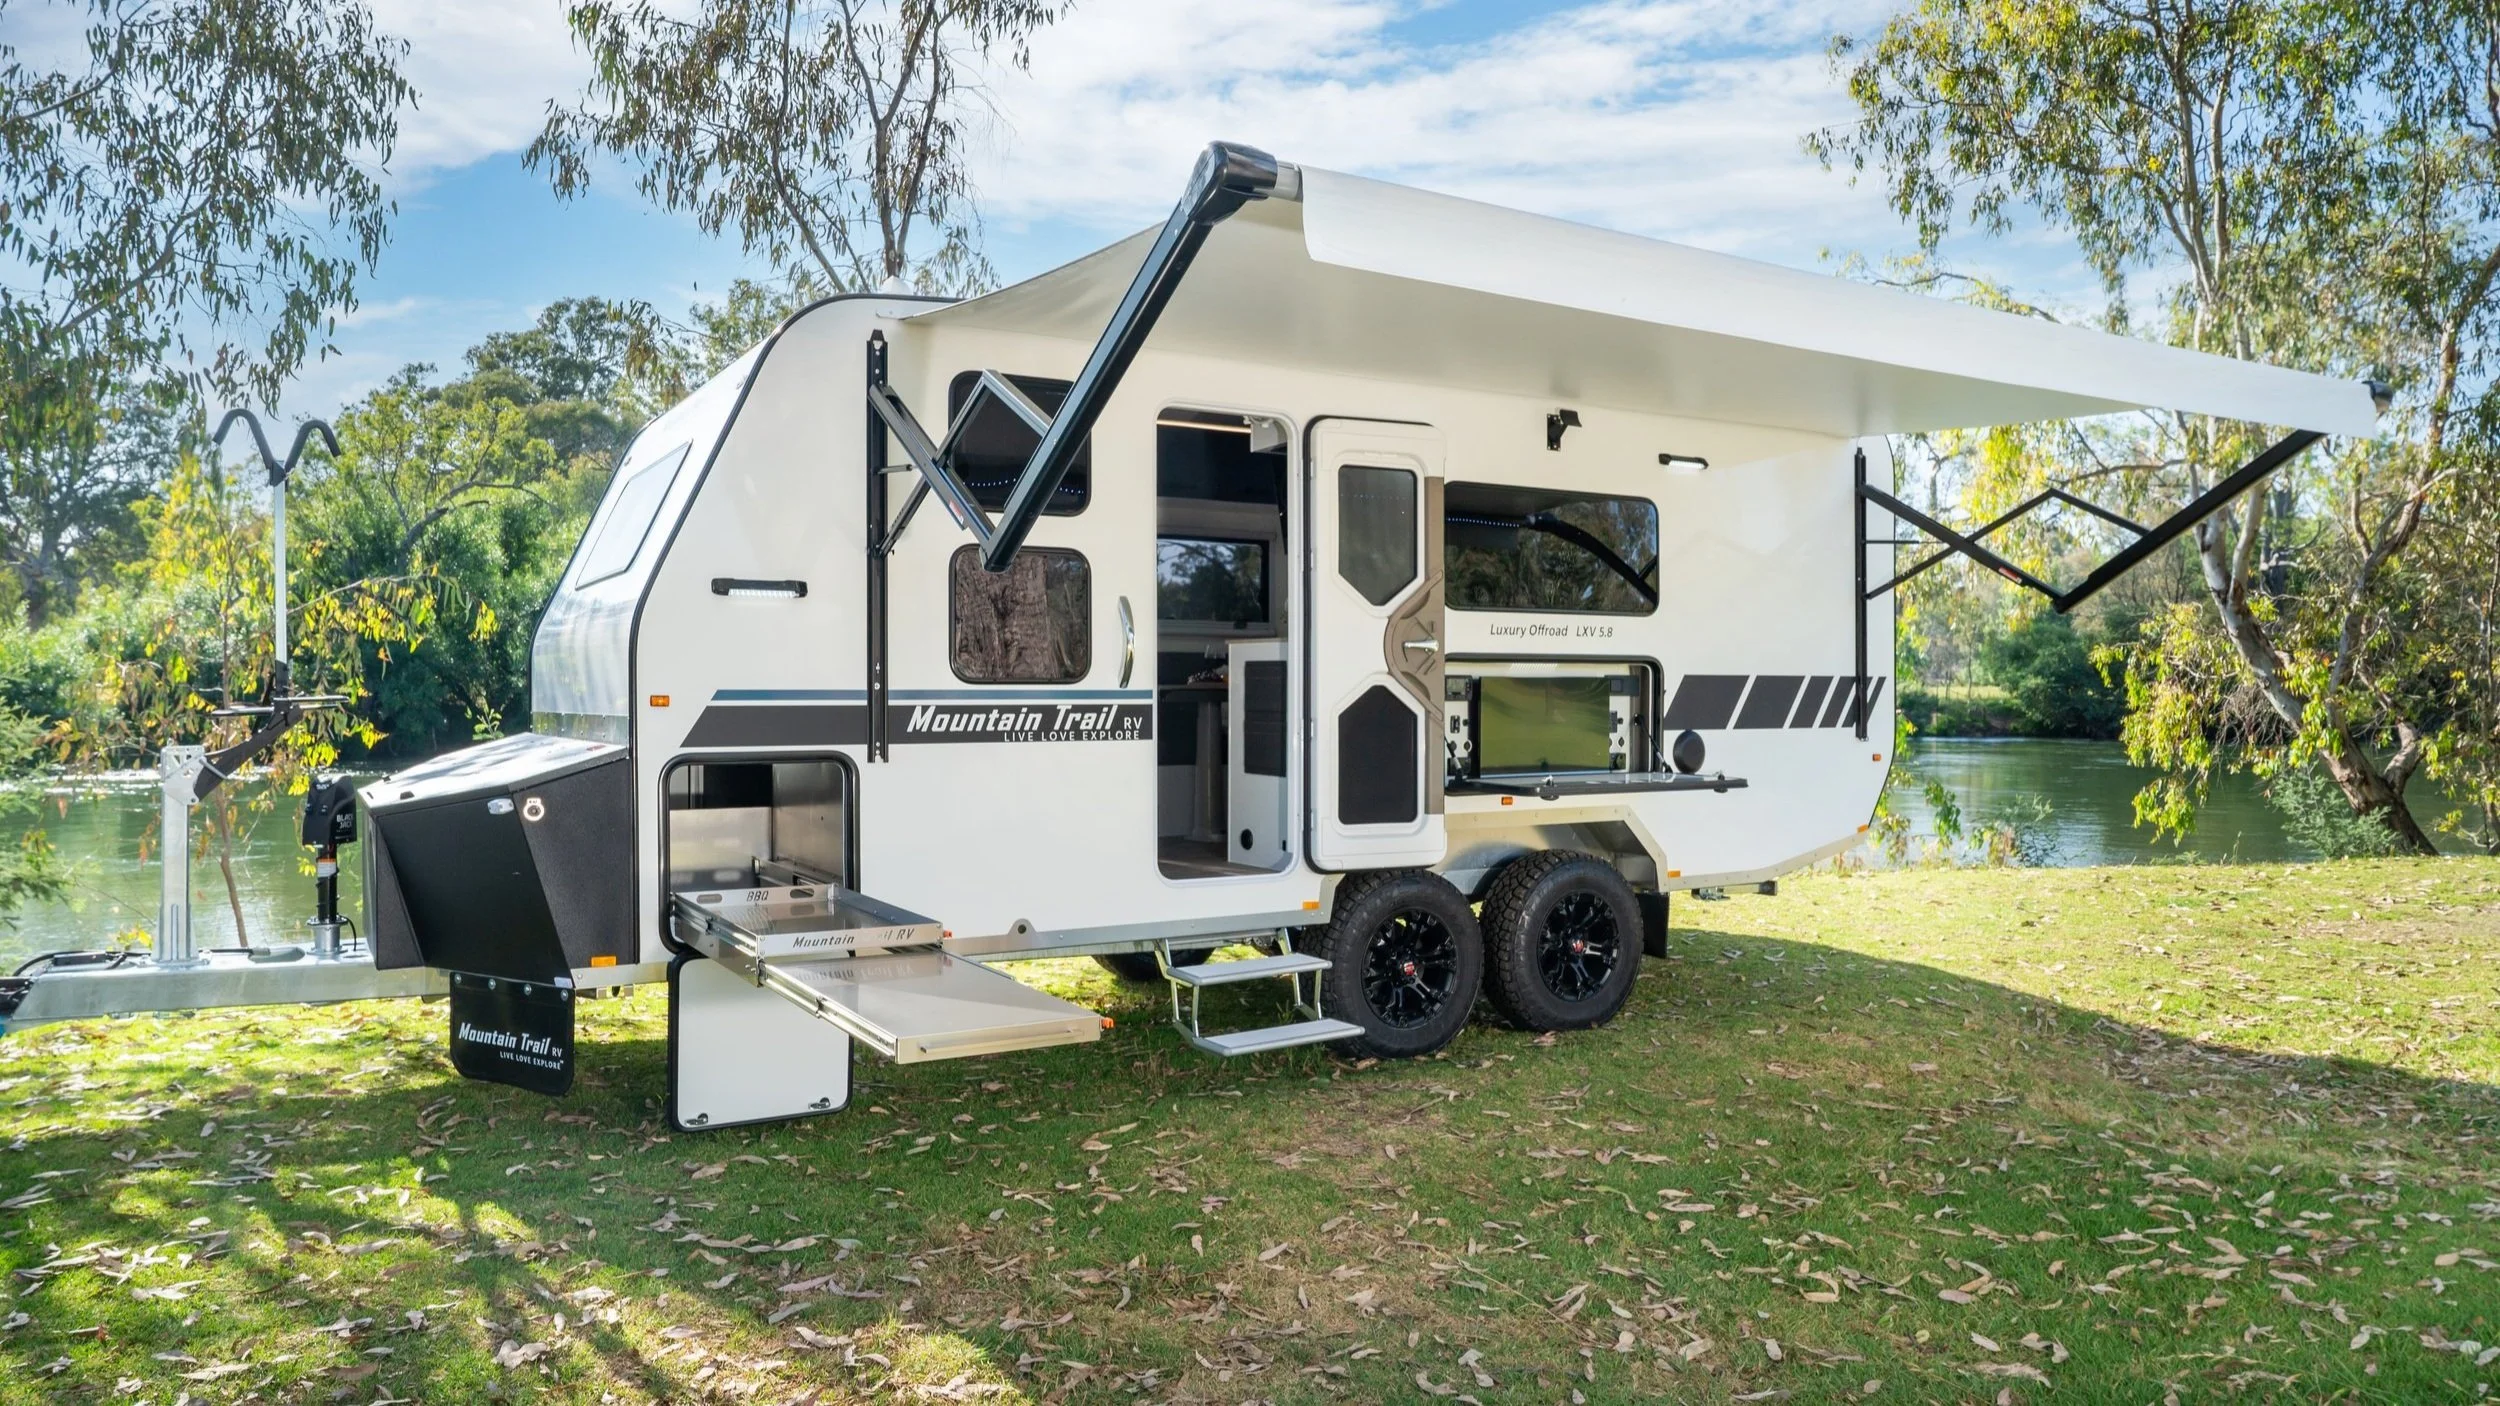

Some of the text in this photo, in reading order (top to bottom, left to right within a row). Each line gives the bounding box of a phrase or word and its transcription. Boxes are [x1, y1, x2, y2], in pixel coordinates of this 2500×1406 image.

[1490, 624, 1613, 639] Luxury Offroad LXV 5.8
[906, 704, 1143, 733] Mountain Trail RV
[1004, 730, 1140, 742] LIVE LOVE EXPLORE
[746, 890, 769, 902] BBQ
[793, 935, 855, 948] Mountain
[896, 928, 915, 941] RV
[459, 1021, 562, 1058] Mountain Trail RV
[500, 1051, 514, 1061] LIVE
[516, 1054, 531, 1065] LOVE
